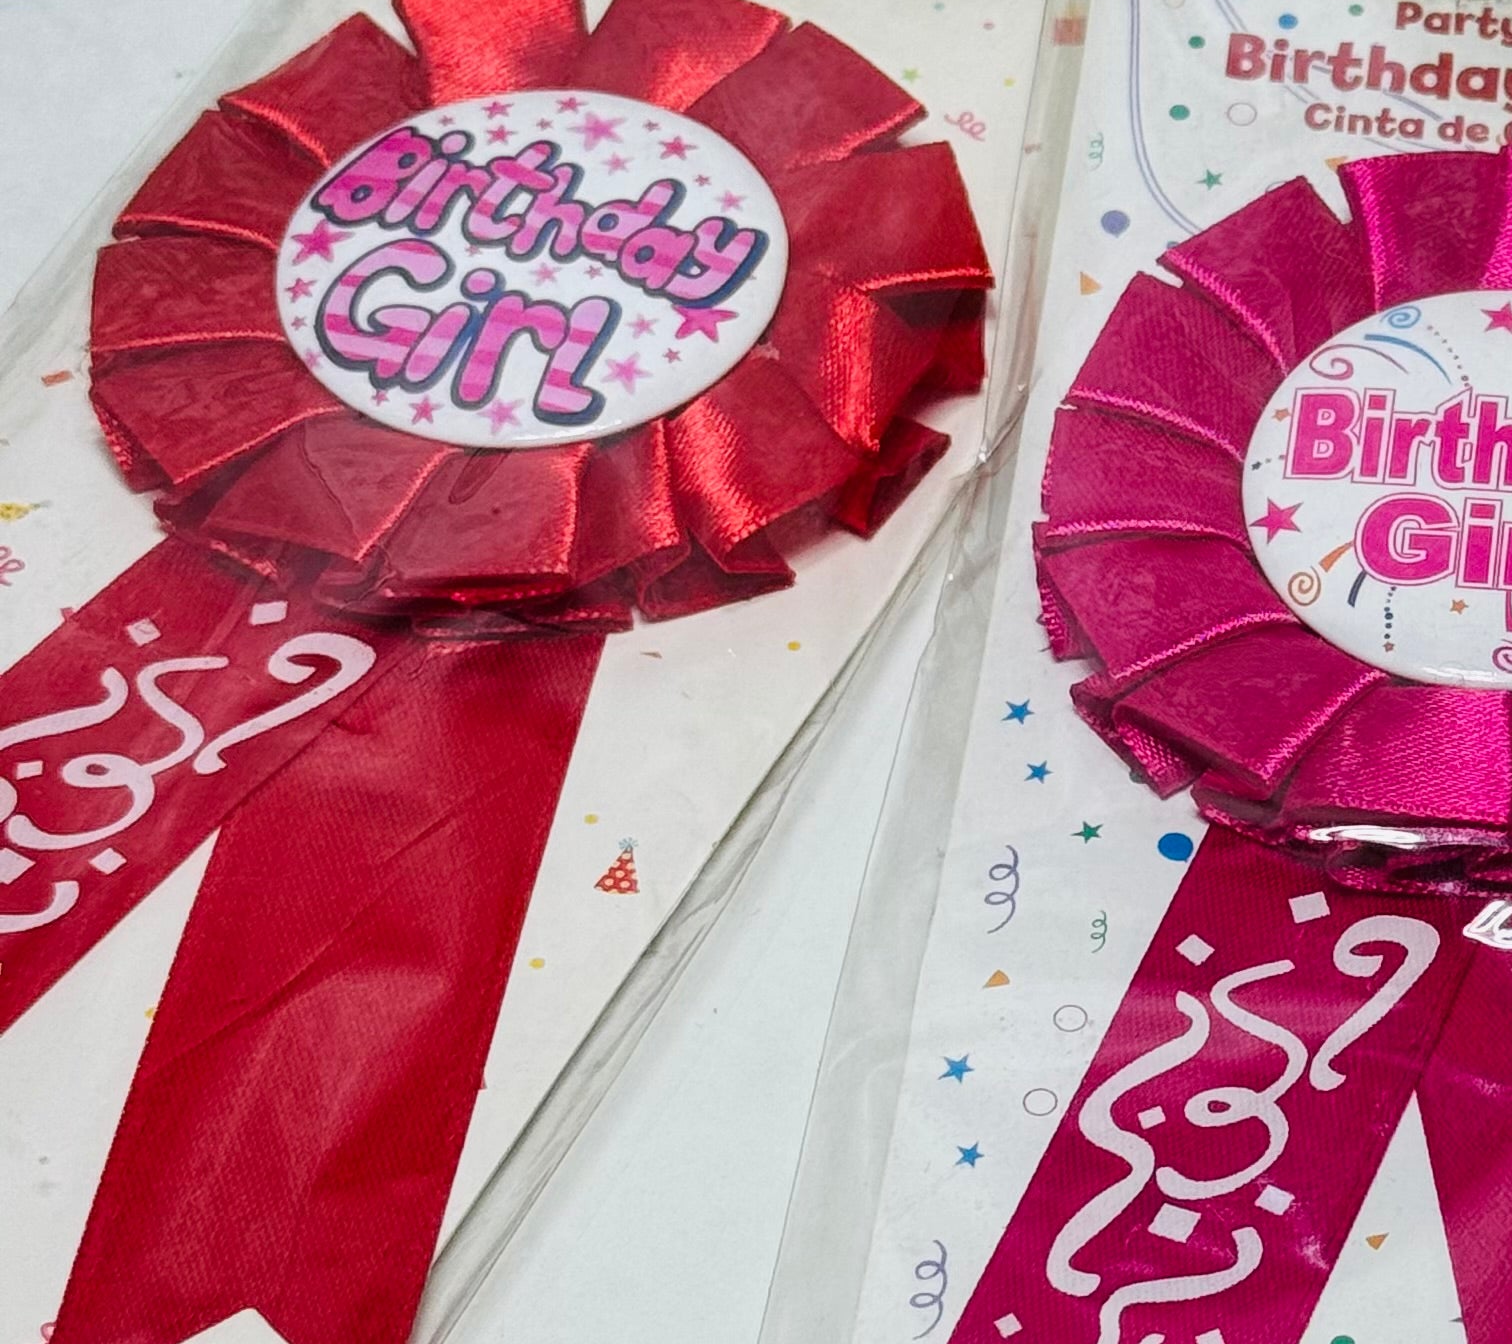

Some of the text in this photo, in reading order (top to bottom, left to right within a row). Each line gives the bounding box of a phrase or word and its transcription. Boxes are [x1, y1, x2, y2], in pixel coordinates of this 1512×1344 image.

[1304, 102, 1425, 140] Cinta
[1437, 115, 1490, 144] de
[310, 126, 769, 307] Birthday
